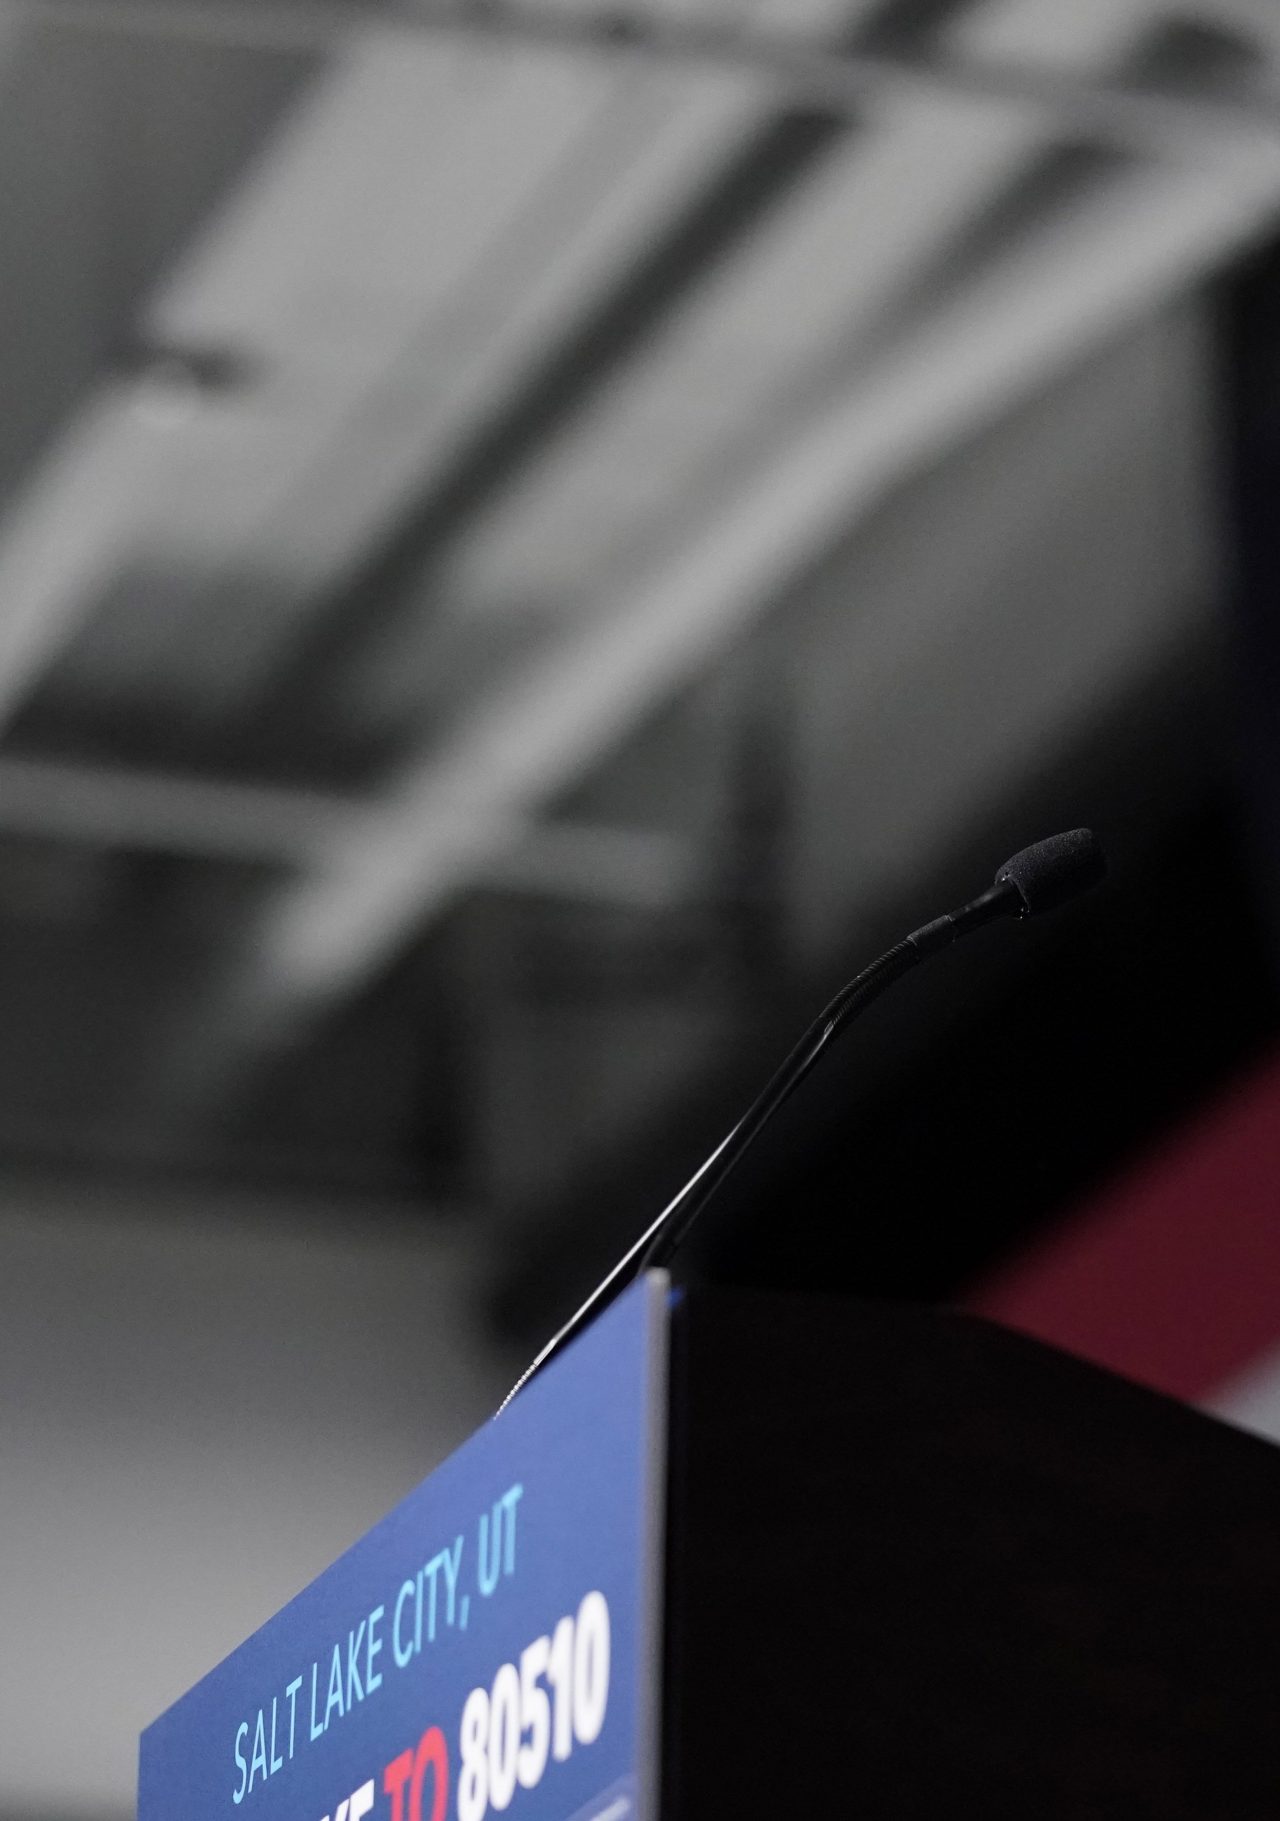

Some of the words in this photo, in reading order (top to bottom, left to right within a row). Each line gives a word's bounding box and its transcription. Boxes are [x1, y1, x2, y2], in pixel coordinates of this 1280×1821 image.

[232, 1675, 303, 1805] SALT
[310, 1604, 385, 1742] LAKE
[393, 1534, 469, 1668] CITY,
[478, 1483, 523, 1597] UT
[457, 1590, 611, 1821] 80510
